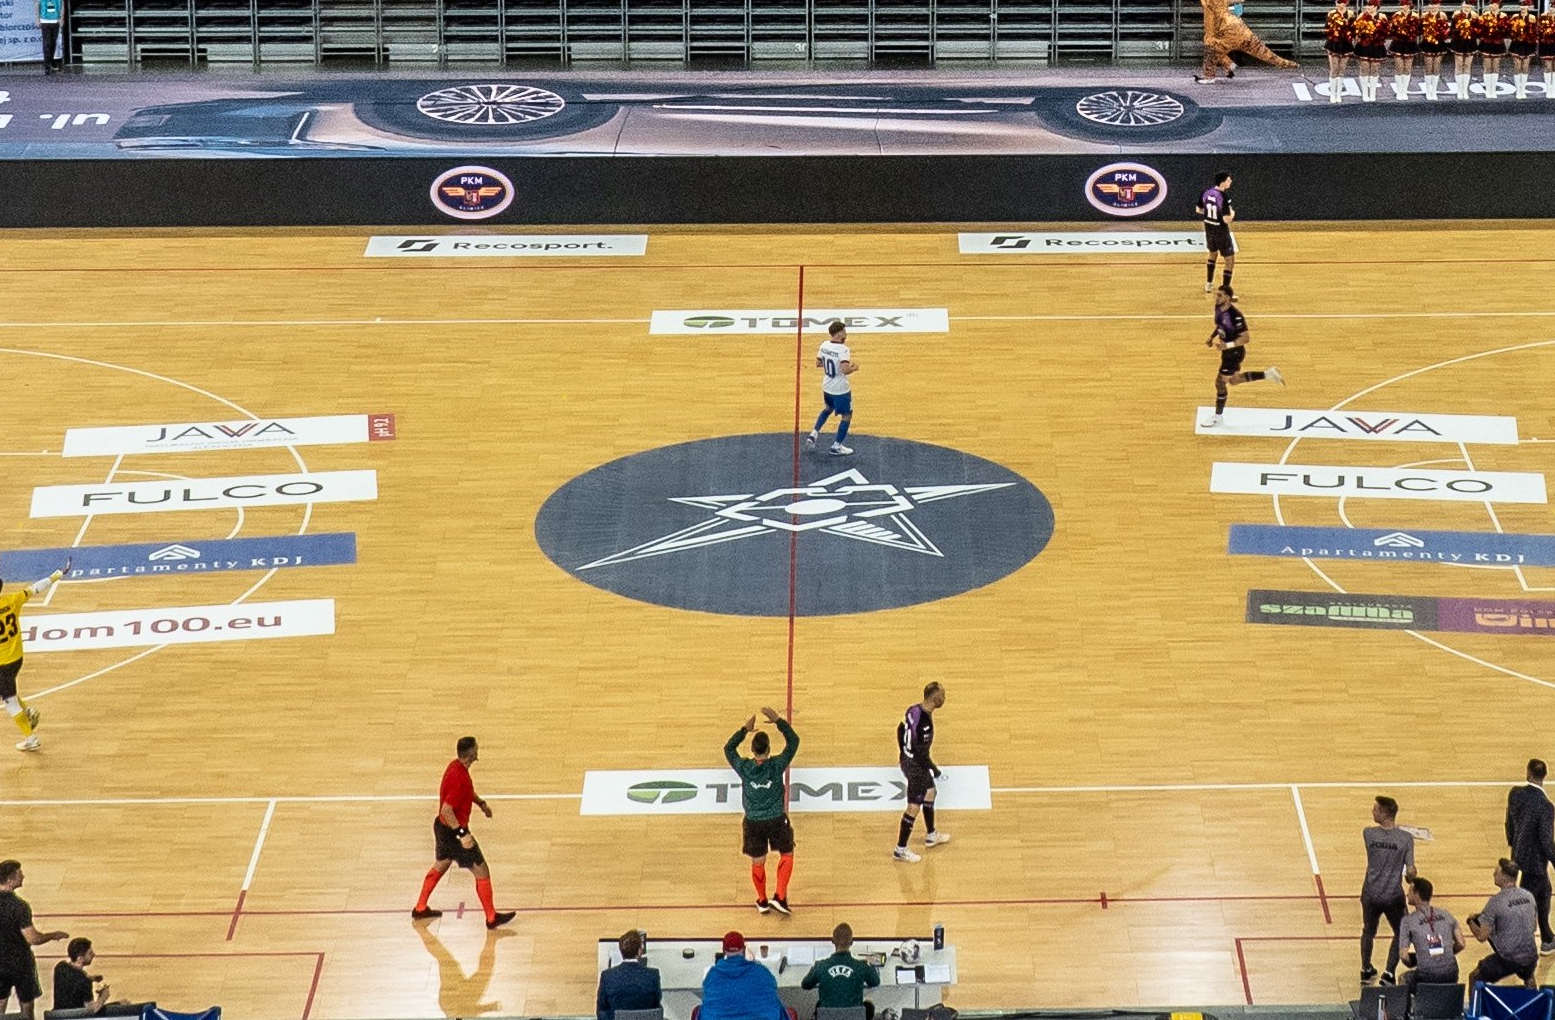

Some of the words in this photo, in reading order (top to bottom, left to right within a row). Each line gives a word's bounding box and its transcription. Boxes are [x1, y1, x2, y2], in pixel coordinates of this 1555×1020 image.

[39, 112, 111, 130] ul.
[461, 176, 483, 185] PKM
[1115, 173, 1137, 182] PKM
[1206, 202, 1217, 220] 11
[453, 241, 613, 252] Recosport.
[1046, 238, 1204, 247] Recosport.
[146, 421, 296, 443] JAVA
[1270, 414, 1443, 436] JAVA
[1260, 473, 1493, 493] FULCO
[82, 482, 324, 506] FULCO
[1280, 546, 1461, 561] Apartamenty
[1475, 552, 1525, 564] KDJ
[71, 560, 238, 579] partamenty
[250, 554, 304, 568] KDJ
